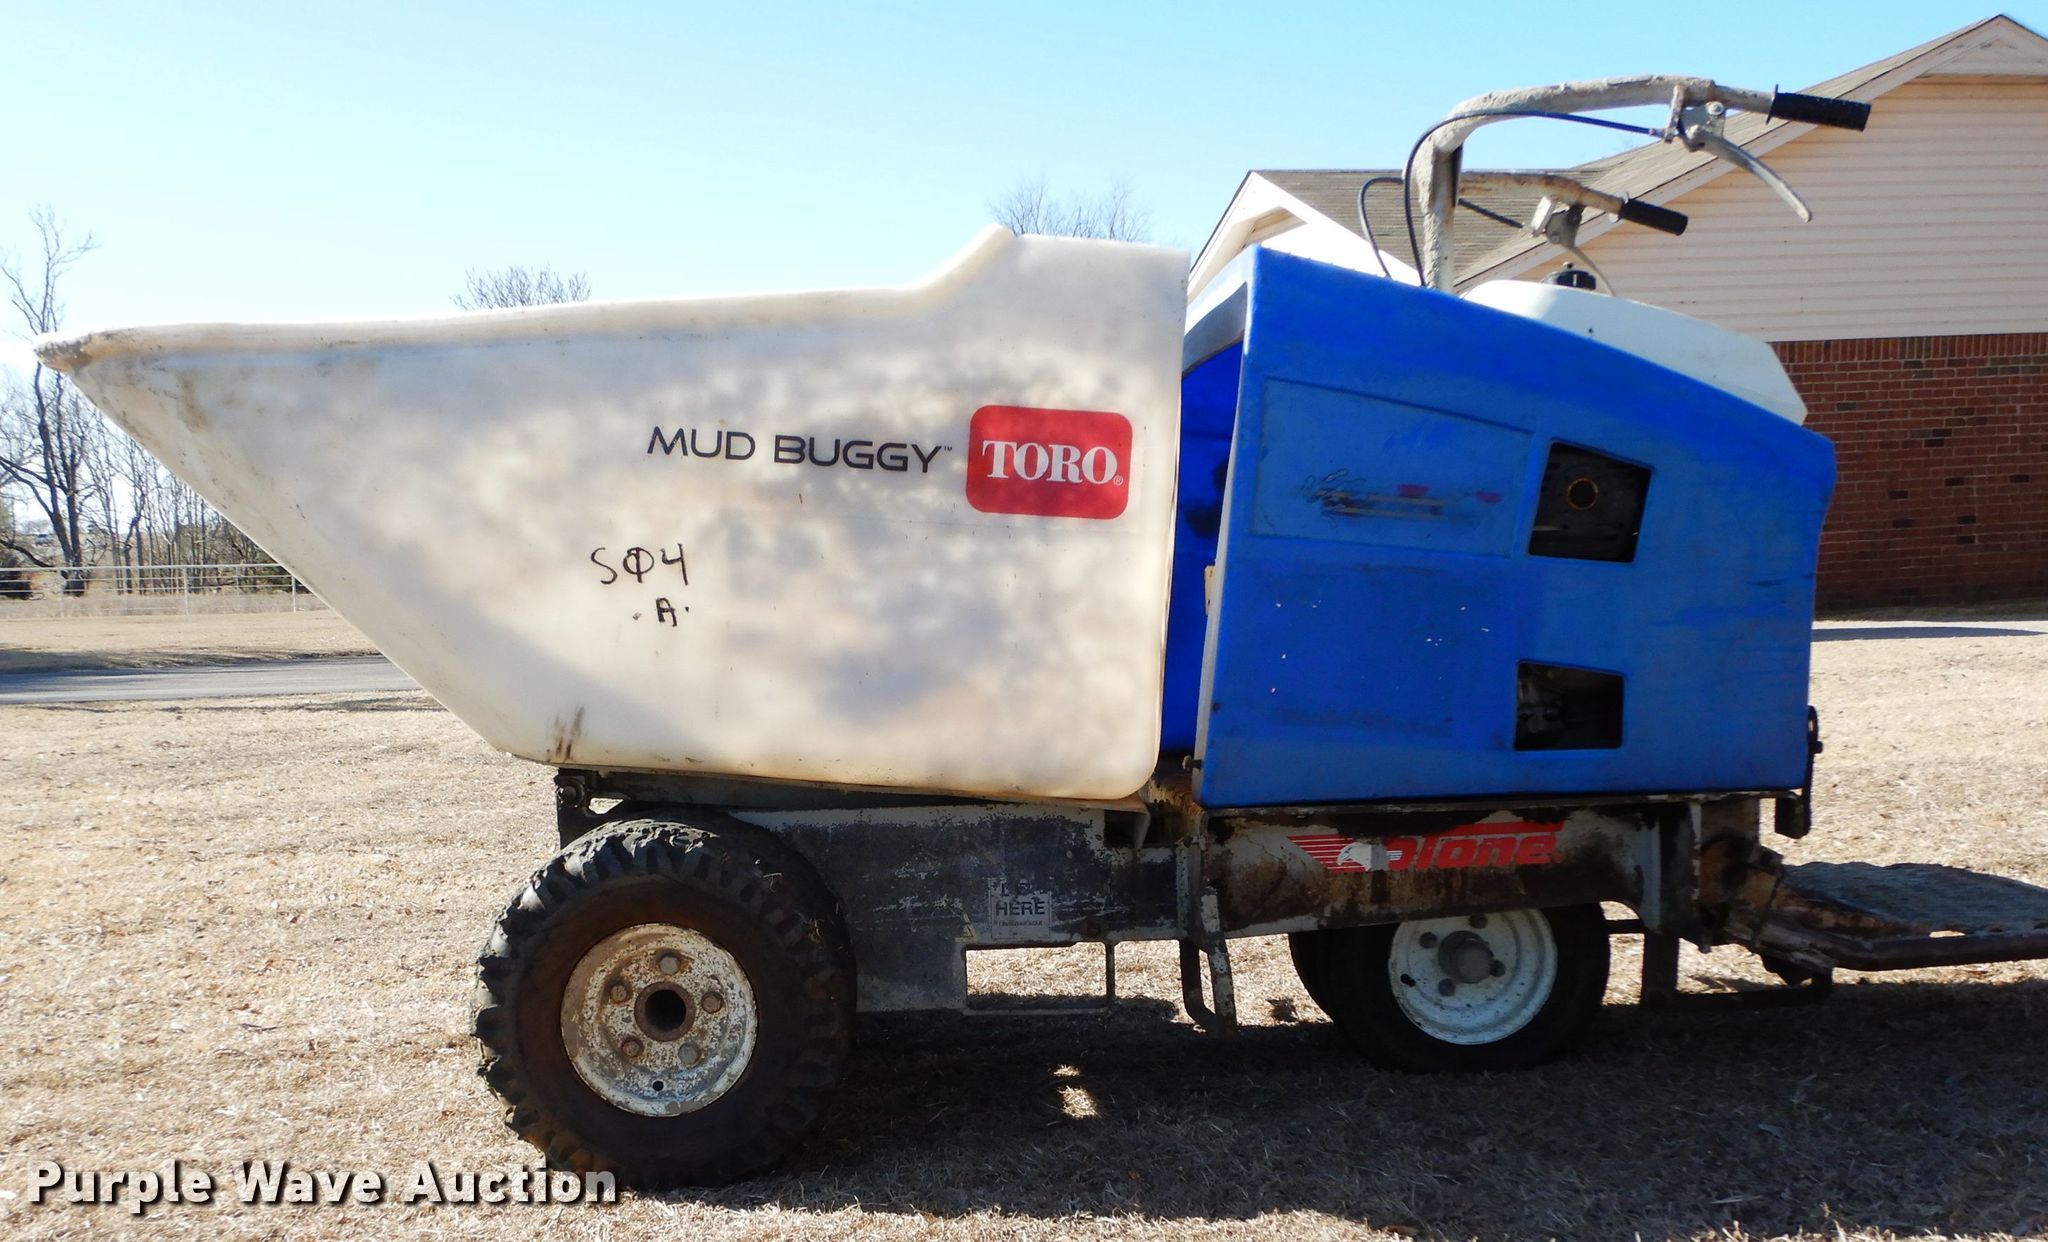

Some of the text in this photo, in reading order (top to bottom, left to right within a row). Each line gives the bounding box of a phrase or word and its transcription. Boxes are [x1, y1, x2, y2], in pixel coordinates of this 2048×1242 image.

[647, 426, 942, 473] MUD BUGGY
[982, 440, 1118, 484] TORO
[995, 900, 1045, 917] HERE
